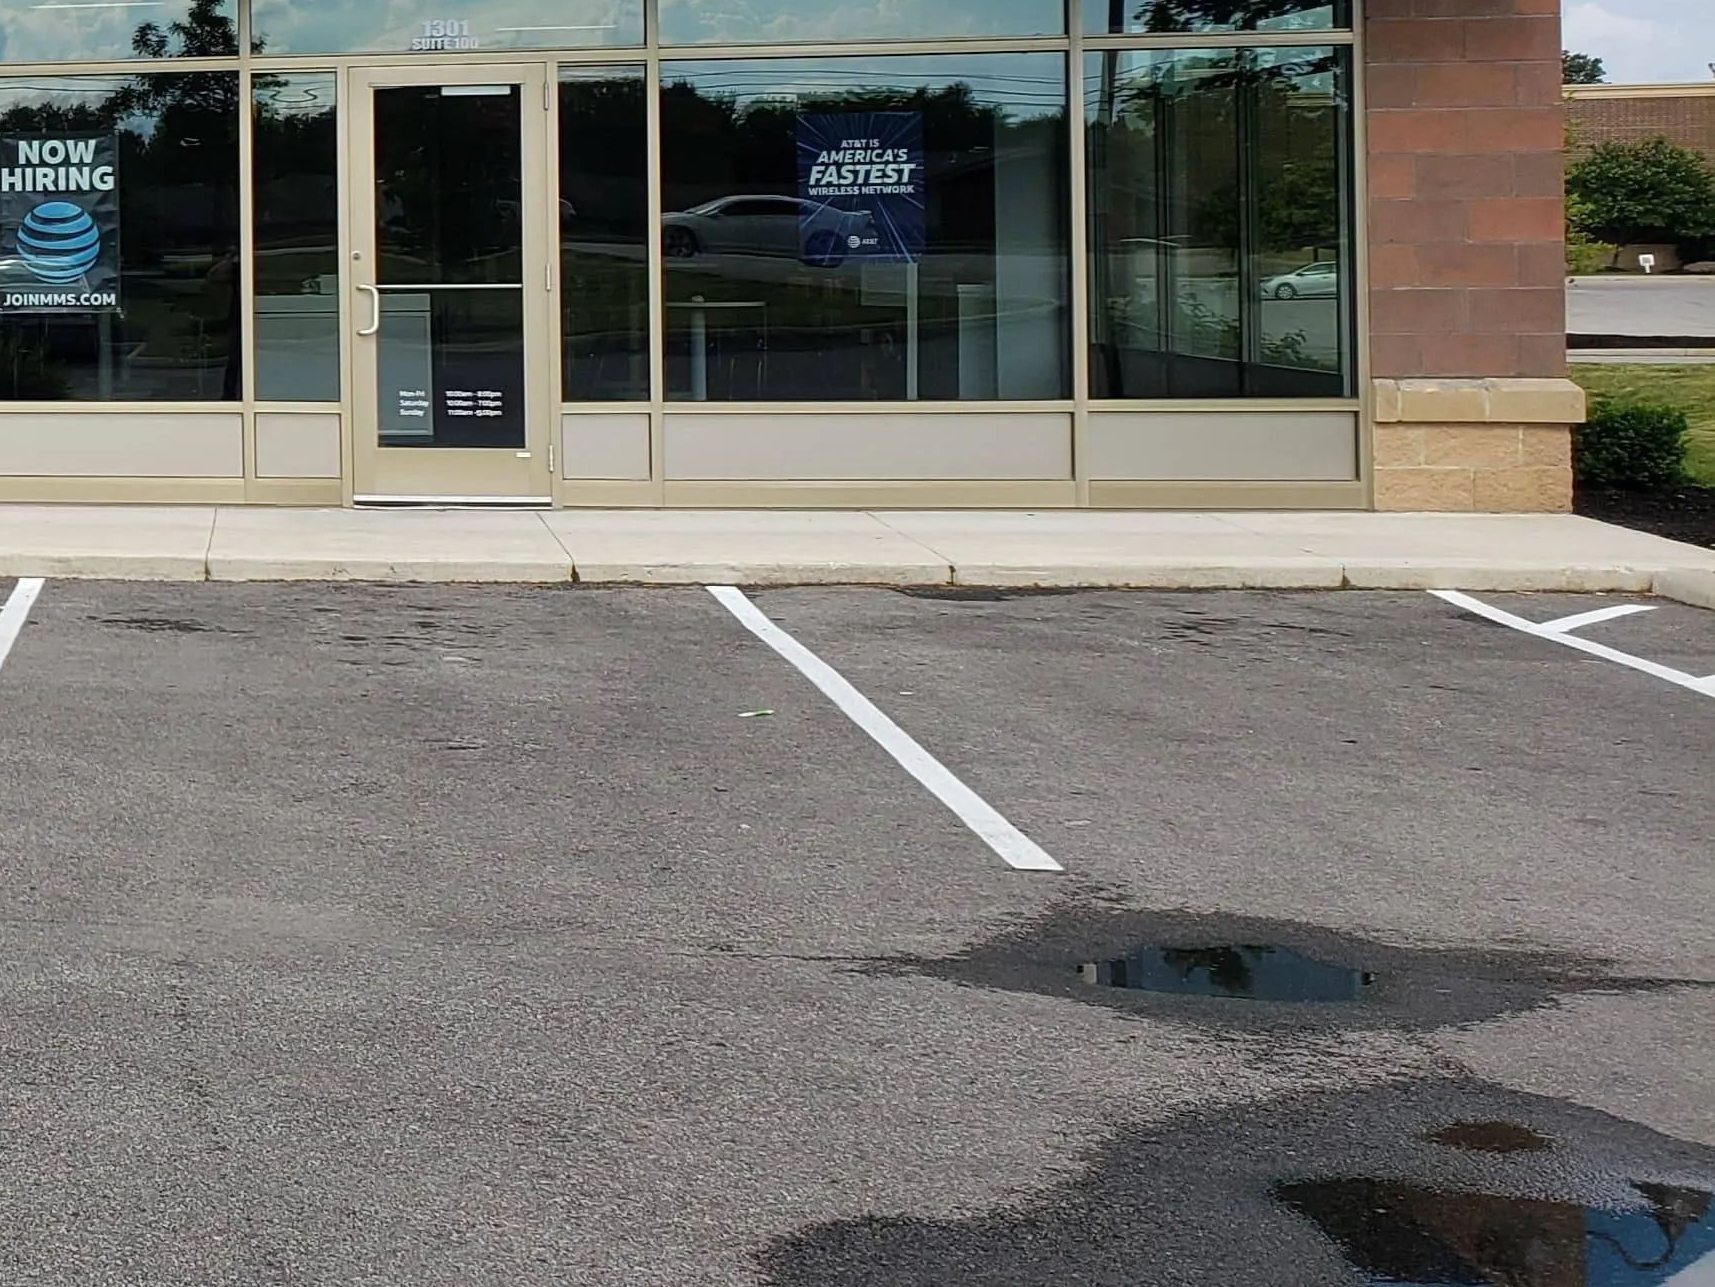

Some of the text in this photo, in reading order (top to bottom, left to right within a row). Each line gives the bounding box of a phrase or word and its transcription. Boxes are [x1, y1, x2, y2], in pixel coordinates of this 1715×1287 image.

[422, 19, 469, 37] 1301
[412, 37, 478, 50] SUITE 100
[840, 139, 880, 148] AT&T IS
[18, 139, 96, 164] NOW
[816, 148, 908, 163] AMERICA'S
[1, 165, 115, 192] HIRING
[808, 163, 916, 185] FASTEST
[808, 185, 915, 196] WIRELESS NETWORK
[3, 293, 116, 306] JOINMMS.COM
